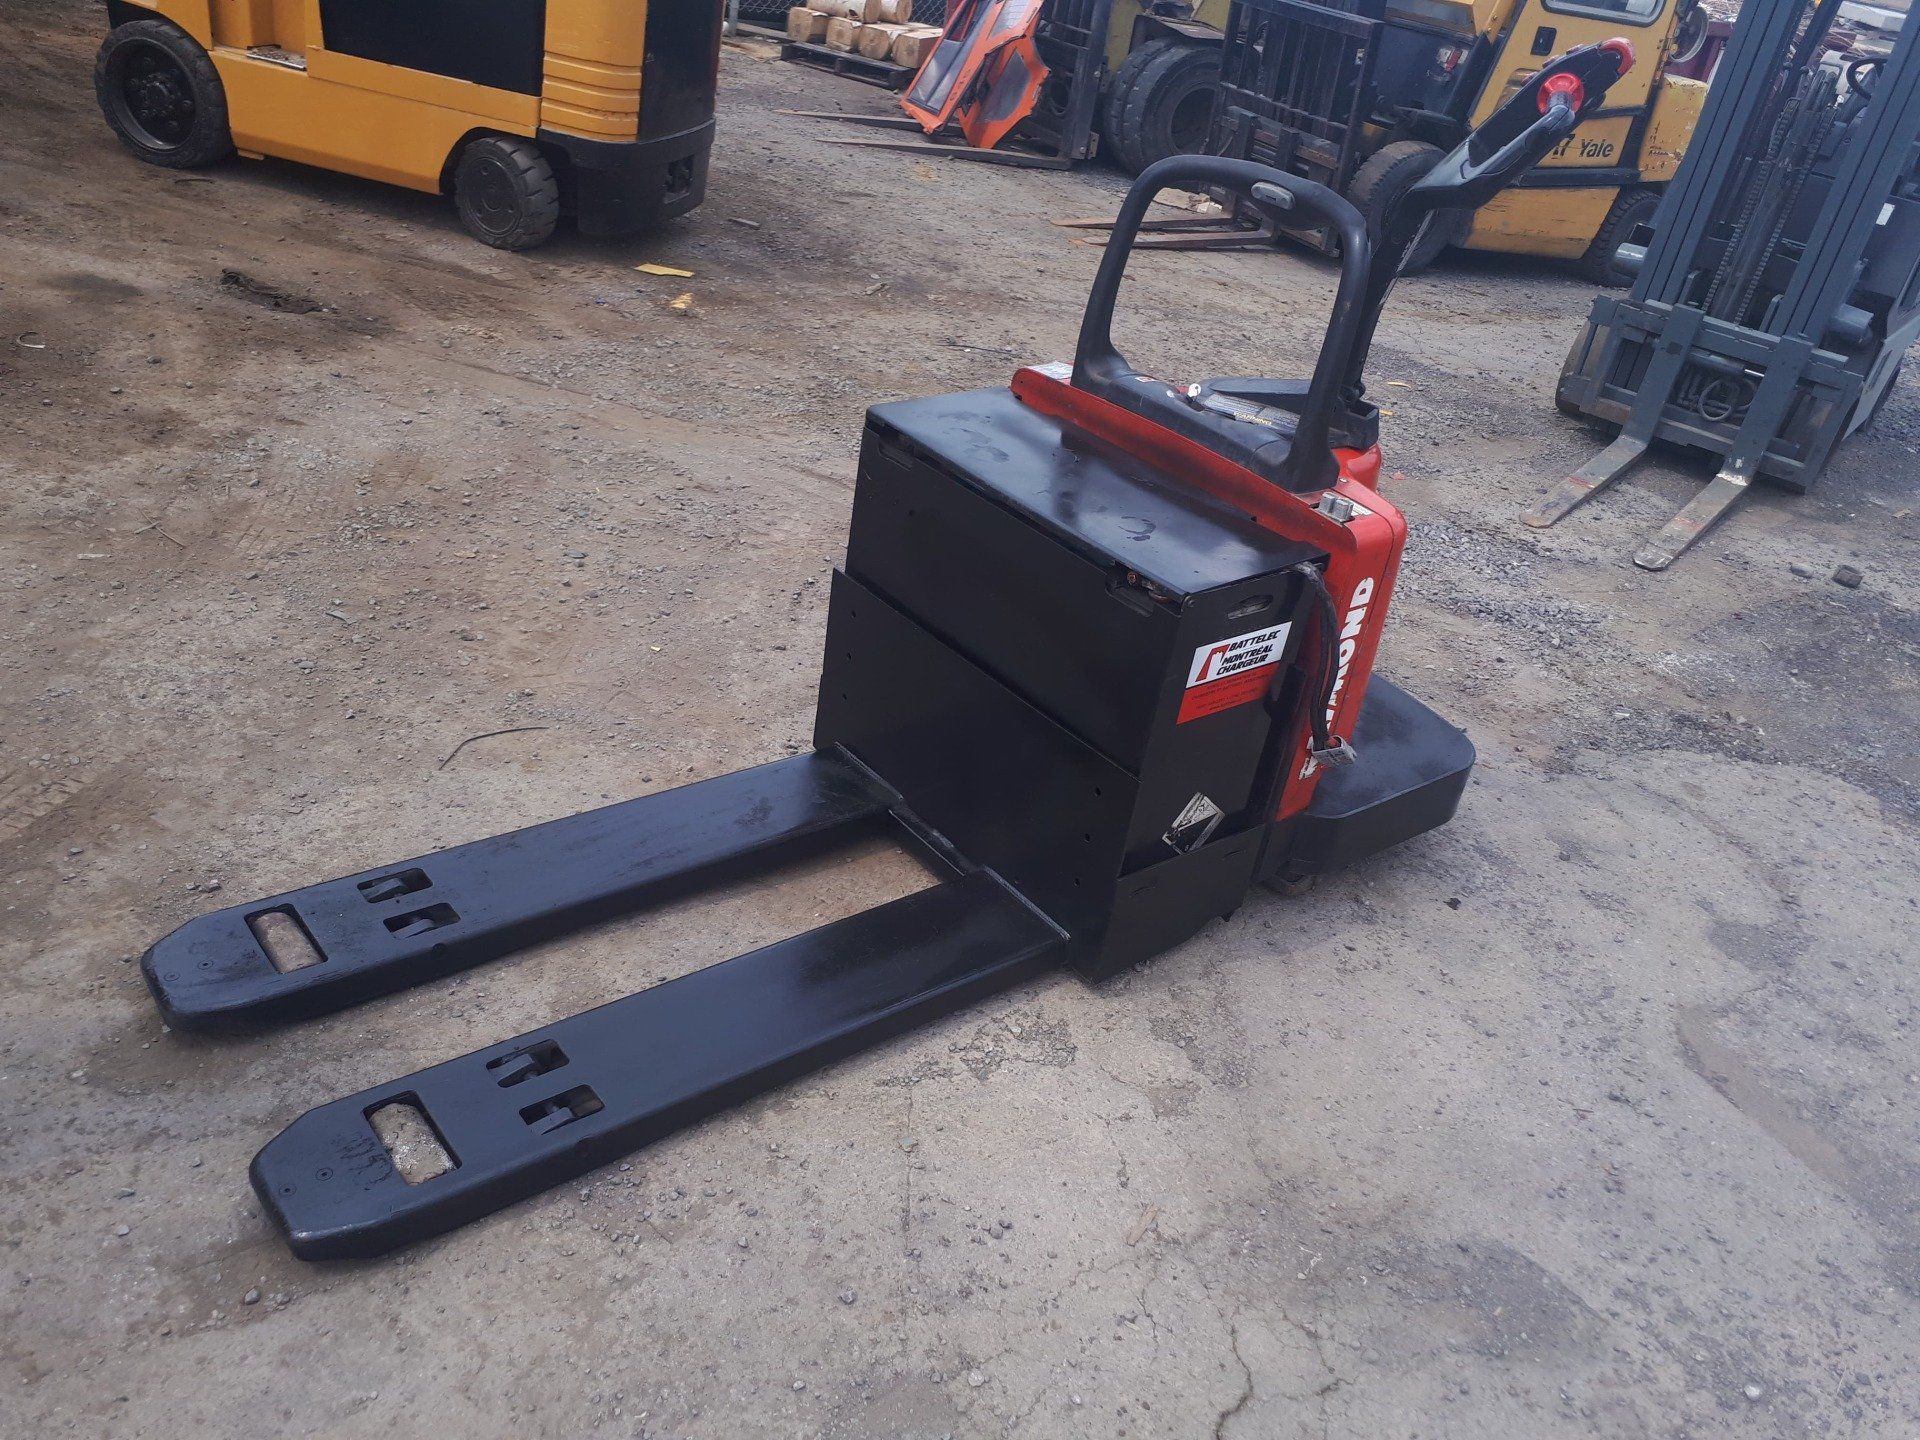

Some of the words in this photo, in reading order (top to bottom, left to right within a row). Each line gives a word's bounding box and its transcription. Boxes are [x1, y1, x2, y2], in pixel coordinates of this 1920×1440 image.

[1579, 138, 1614, 158] Yale
[1228, 629, 1281, 652] BATTELEC
[1216, 654, 1268, 676] CHARGEUR
[1221, 643, 1274, 666] MONTRÉAL
